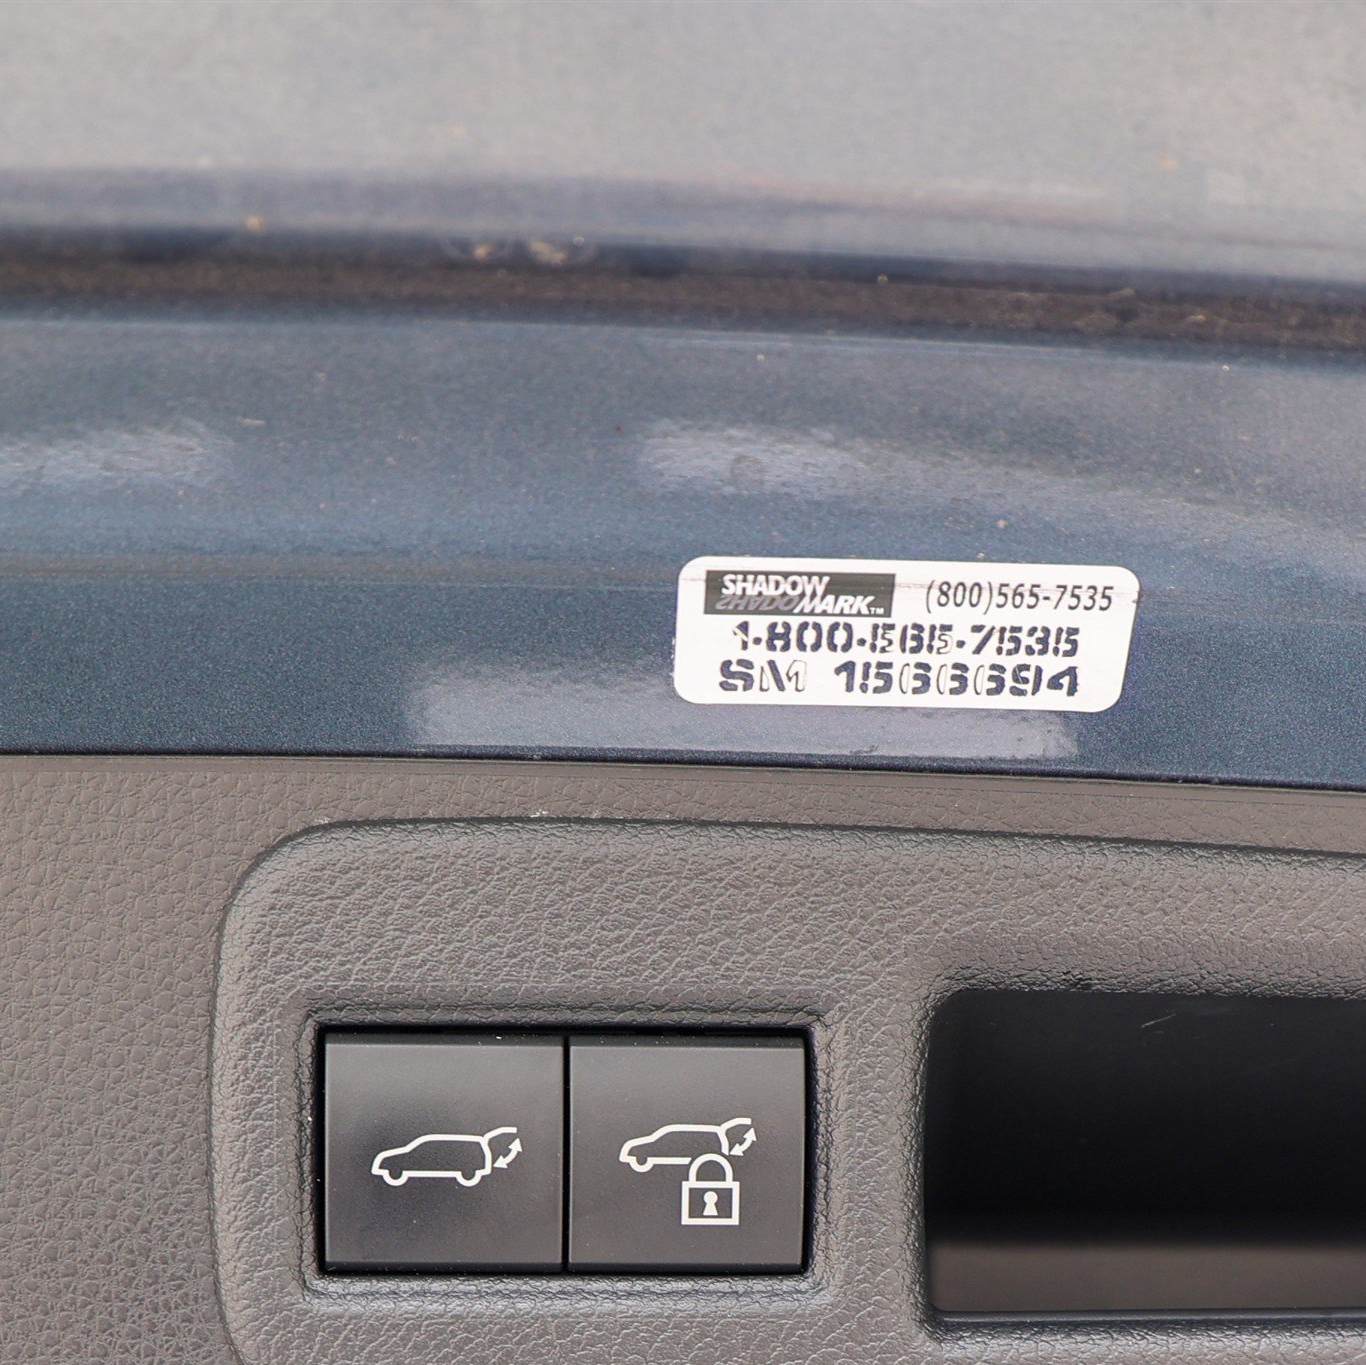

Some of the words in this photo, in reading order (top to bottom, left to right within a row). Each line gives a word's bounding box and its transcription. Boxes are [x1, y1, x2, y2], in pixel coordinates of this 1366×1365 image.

[721, 574, 831, 596] SHADOW
[926, 580, 1115, 615] (800)565-7535
[732, 620, 1080, 657] 1-800-565-7535
[718, 658, 808, 692] SM
[834, 660, 1080, 697] 1566694
